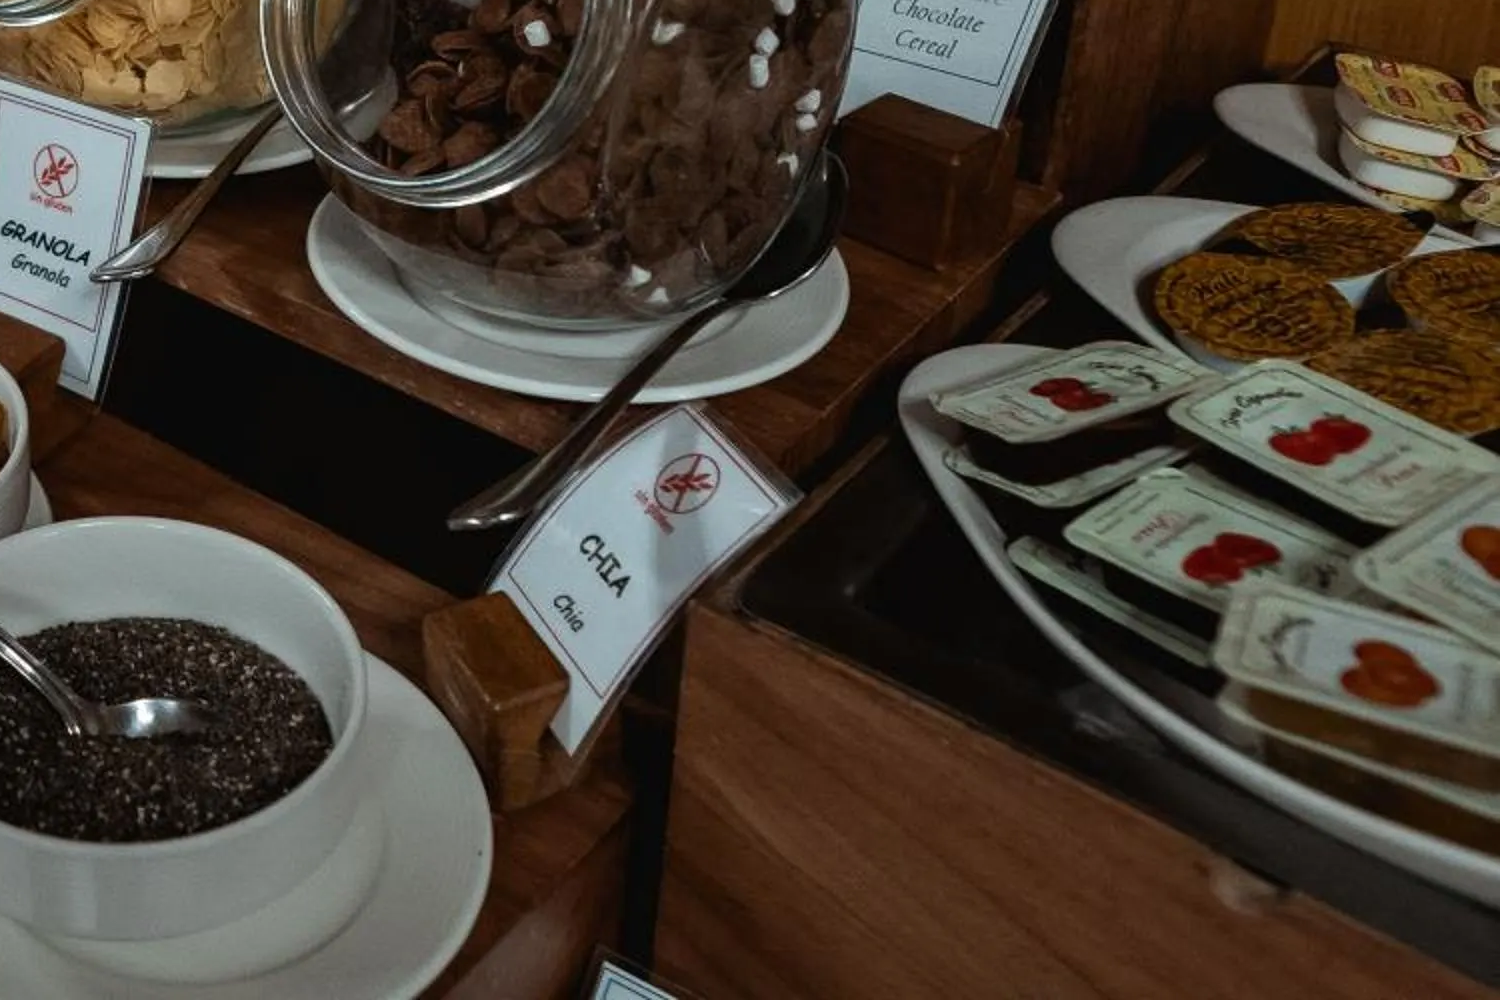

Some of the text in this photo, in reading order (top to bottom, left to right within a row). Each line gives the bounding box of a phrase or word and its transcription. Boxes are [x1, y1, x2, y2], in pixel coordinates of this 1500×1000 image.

[895, 28, 959, 61] Cereal
[0, 220, 91, 266] GRANOLA
[11, 253, 72, 289] Granola
[579, 535, 632, 597] CHIA
[553, 594, 584, 632] Chia
